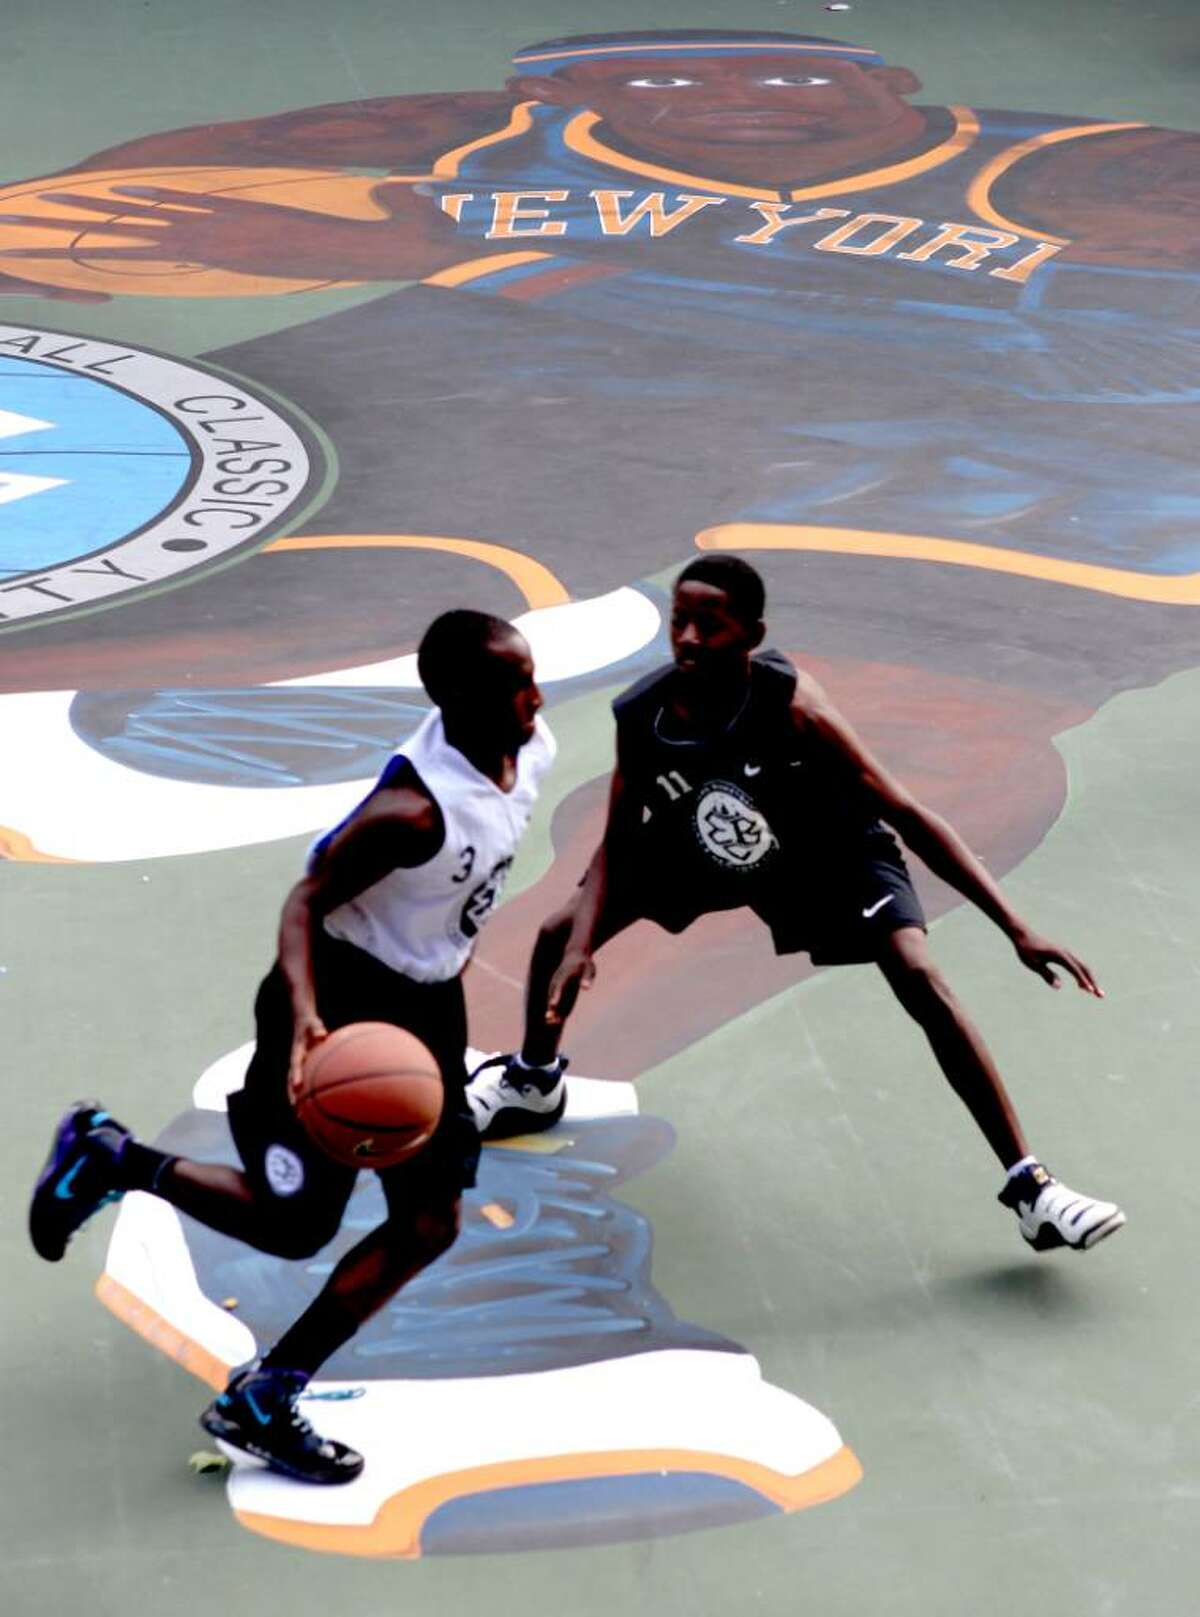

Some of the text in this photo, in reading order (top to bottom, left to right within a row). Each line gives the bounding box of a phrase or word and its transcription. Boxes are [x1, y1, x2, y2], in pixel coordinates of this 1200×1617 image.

[173, 395, 291, 529] CLASSIC
[656, 770, 694, 800] 11
[452, 846, 475, 883] 3
